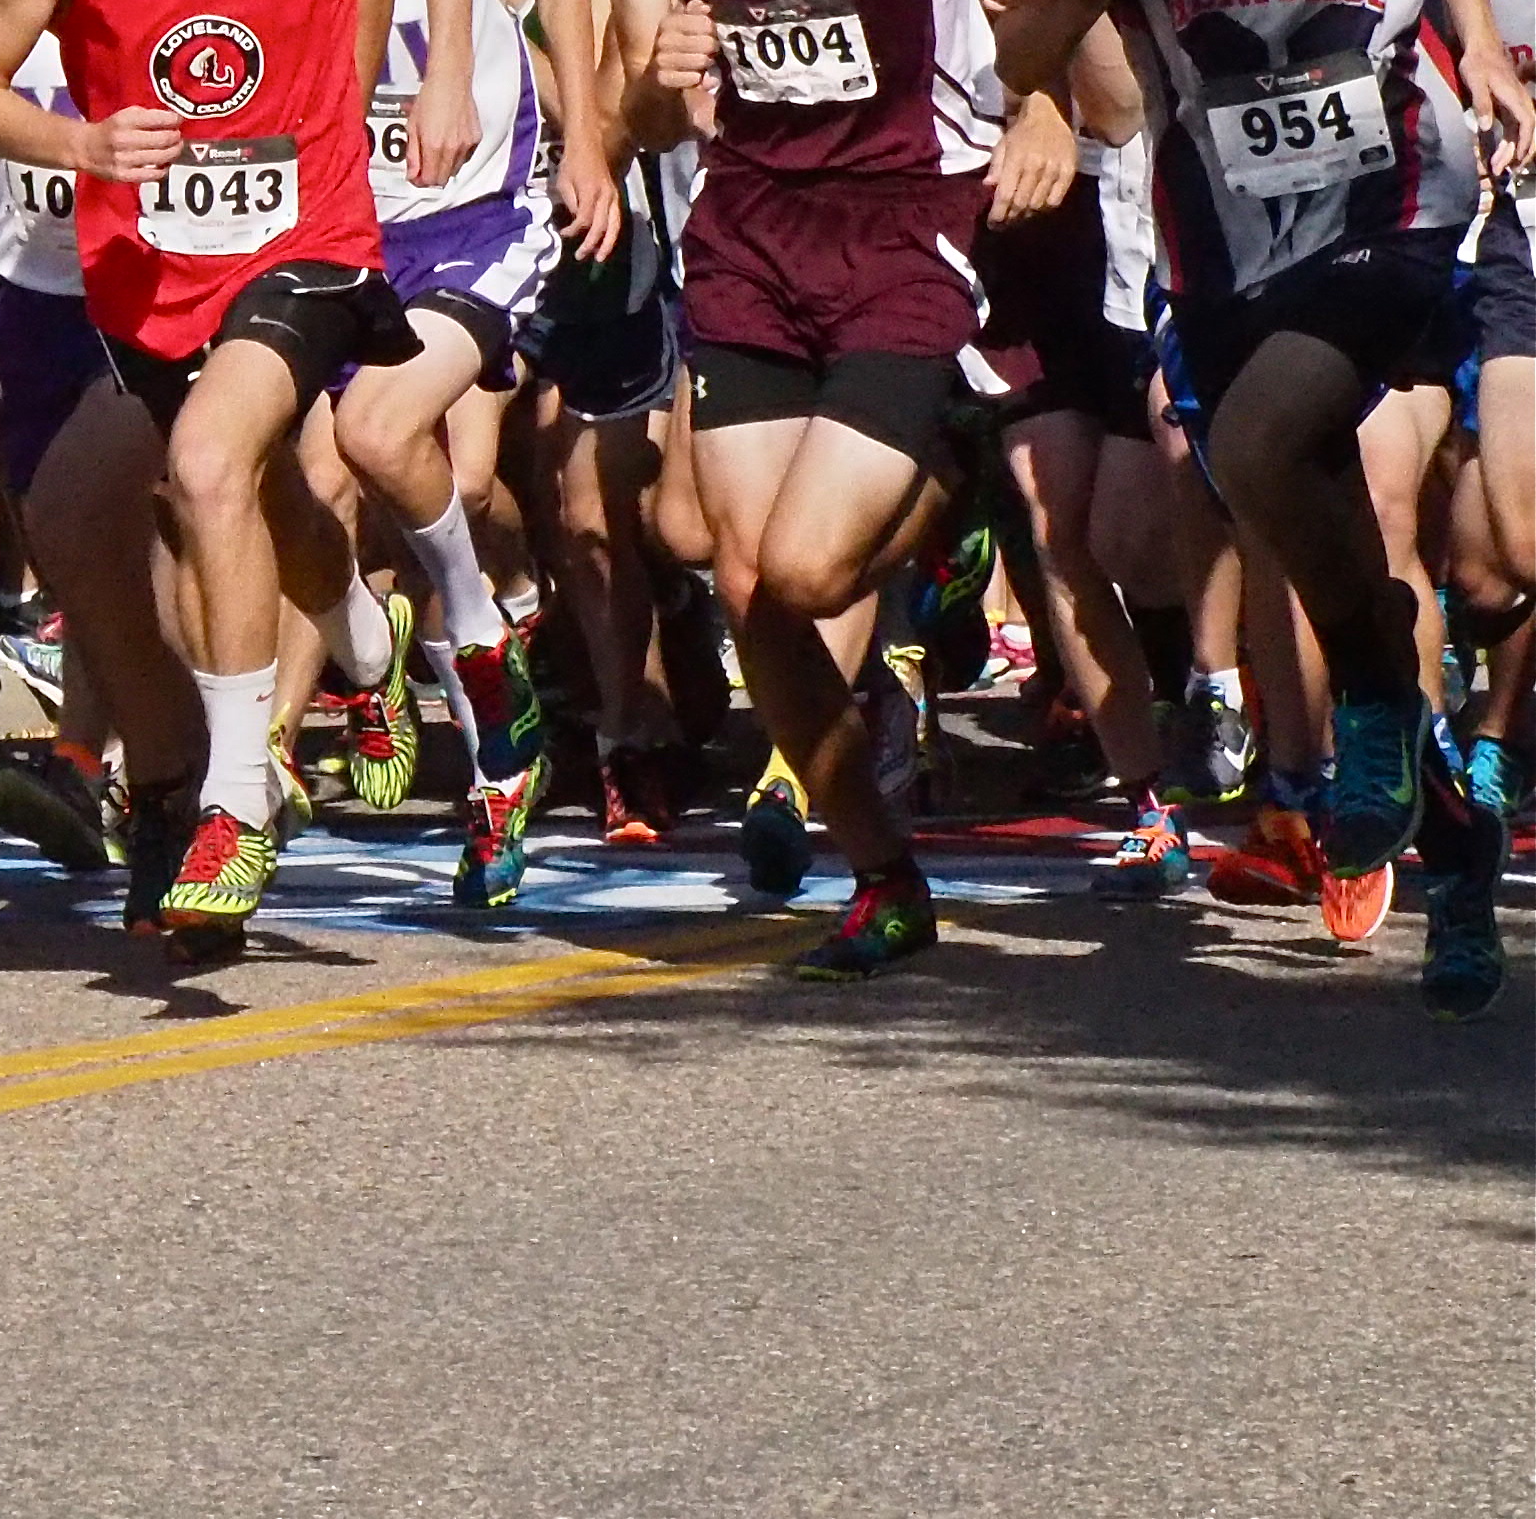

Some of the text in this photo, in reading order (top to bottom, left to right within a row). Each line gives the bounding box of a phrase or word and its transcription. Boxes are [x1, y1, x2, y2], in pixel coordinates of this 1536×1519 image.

[160, 22, 255, 58] LOVELAND
[727, 22, 856, 71] 1004
[196, 75, 255, 115] COUNTRY
[1240, 91, 1356, 158] 954
[154, 168, 283, 217] 1043
